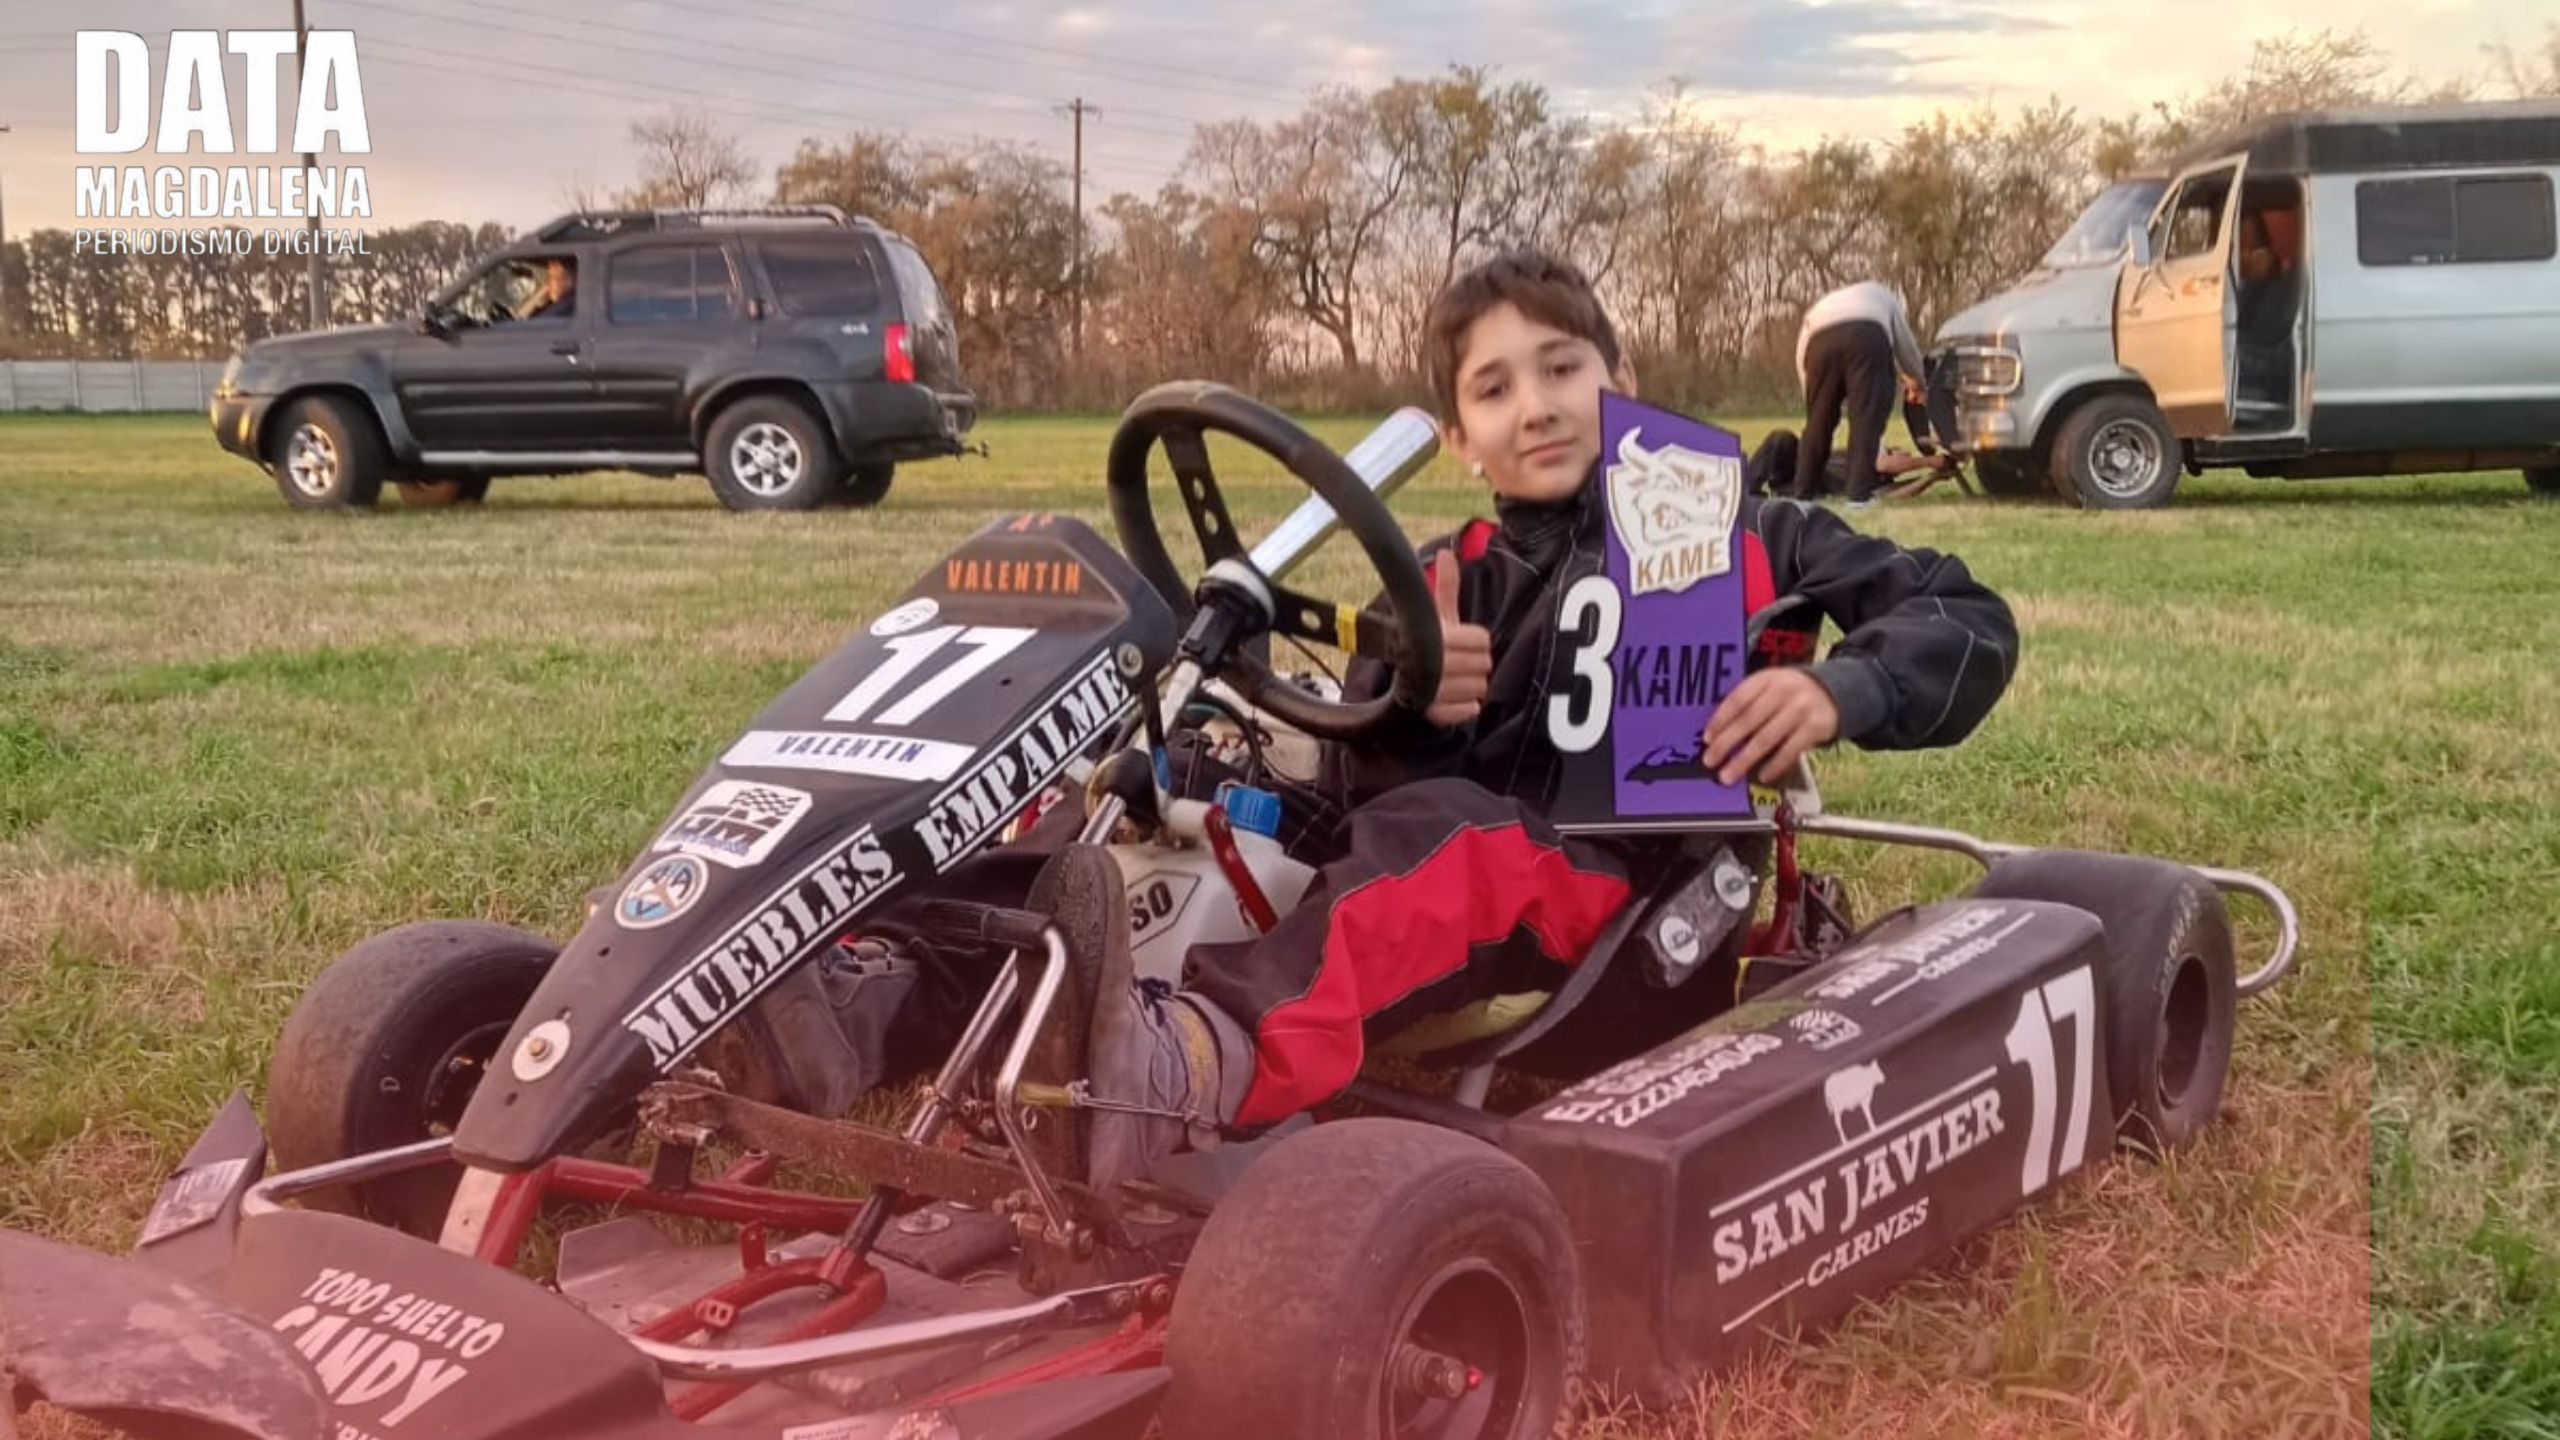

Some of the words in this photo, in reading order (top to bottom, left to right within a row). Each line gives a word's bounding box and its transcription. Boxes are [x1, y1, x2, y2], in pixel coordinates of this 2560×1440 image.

[947, 559, 1080, 593] VALENTIN
[1637, 539, 1726, 589] KAME
[822, 625, 1038, 725] 17
[1548, 575, 1622, 753] 3
[1619, 643, 1738, 708] KAME
[777, 734, 926, 764] VALENTIN
[628, 832, 895, 1069] MUEBLES
[913, 655, 1130, 868] EMPALME
[2004, 965, 2095, 1196] 17
[1712, 1178, 1826, 1285] SAN
[1839, 1087, 2003, 1231] JAVIER
[1806, 1198, 1929, 1288] CARNES
[301, 1268, 391, 1315] TODO
[372, 1293, 504, 1359] SUELTO
